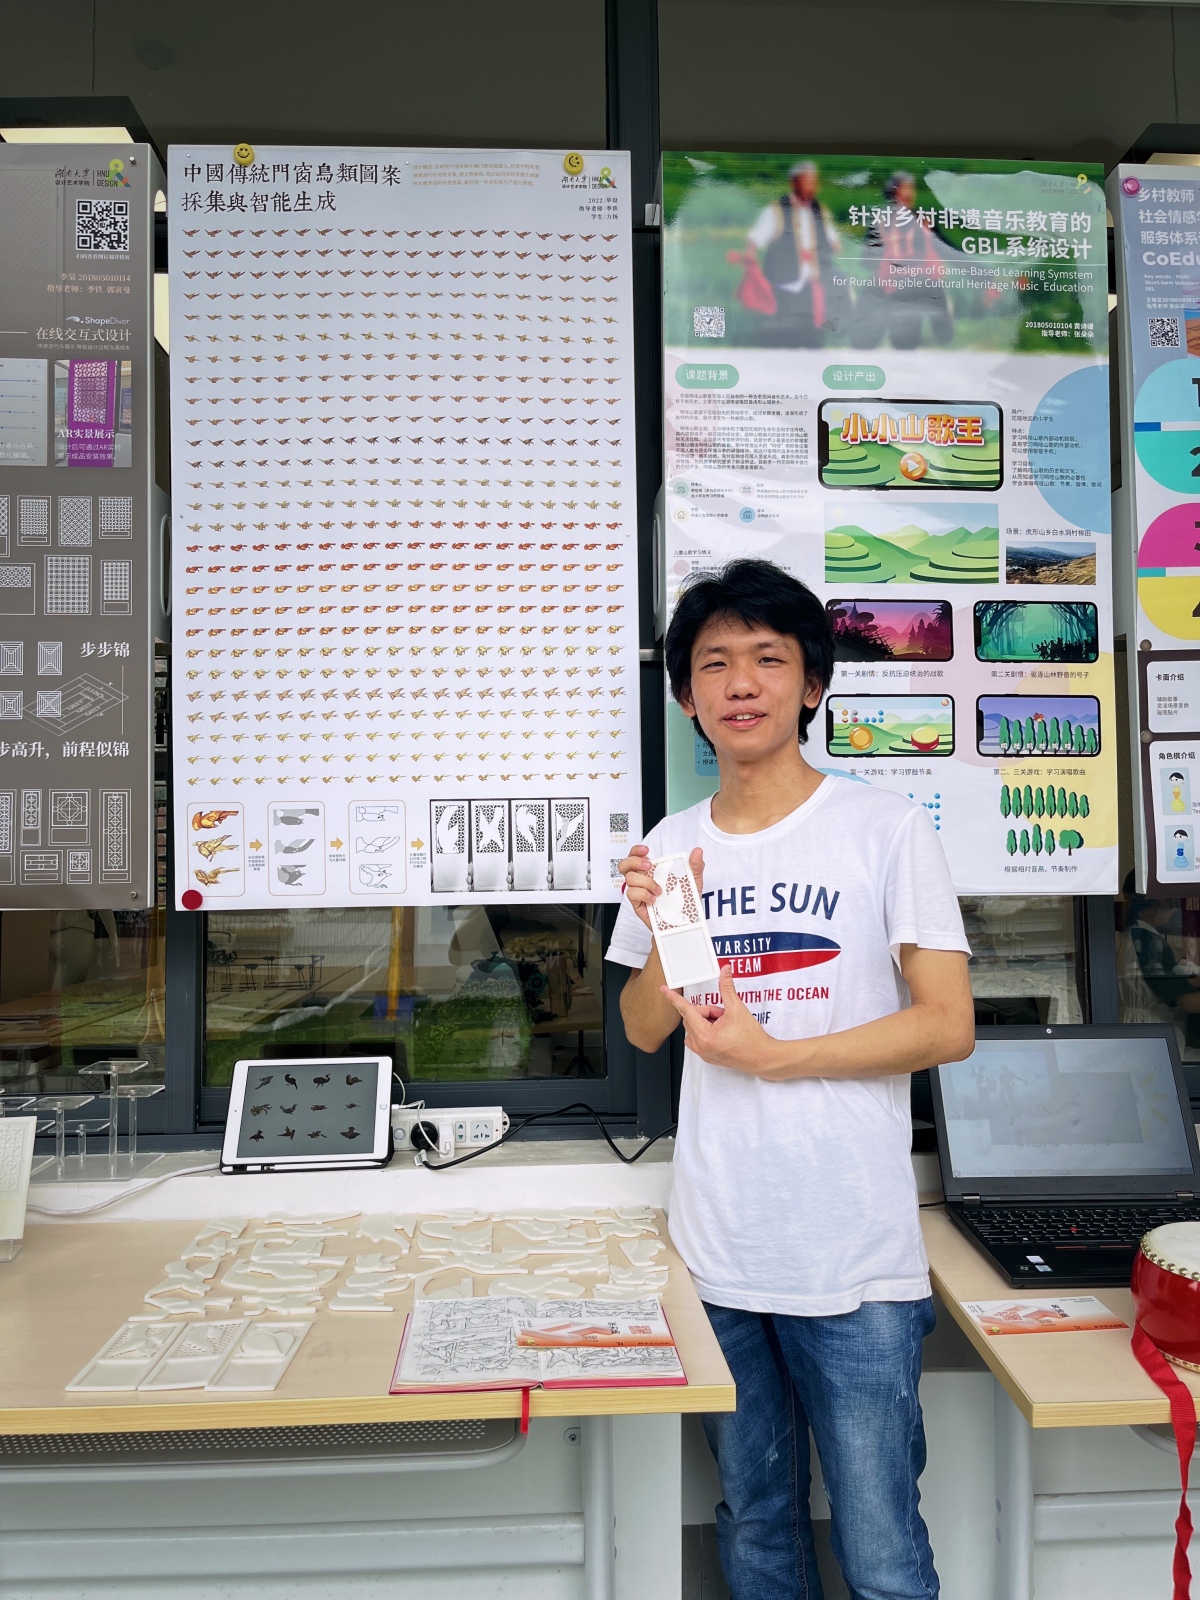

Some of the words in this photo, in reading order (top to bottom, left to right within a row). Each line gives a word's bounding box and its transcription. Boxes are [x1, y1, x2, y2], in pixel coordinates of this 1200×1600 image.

[97, 170, 109, 178] HNU
[181, 190, 337, 214] 採集與智能生成
[1138, 188, 1195, 204] 乡村教师
[848, 205, 1092, 233] 针对乡村非遗音乐教育的
[1140, 230, 1200, 246] 服务体系
[961, 236, 1092, 260] GBL系统设计
[889, 264, 923, 276] Design
[925, 265, 936, 275] of
[937, 266, 1000, 277] Game-Based
[1002, 267, 1045, 280] Learning
[1047, 269, 1093, 281] Symstem
[832, 276, 847, 287] for
[849, 276, 876, 287] Rural
[878, 277, 922, 290] Intagible
[924, 278, 965, 289] Cultural
[967, 279, 1009, 292] Heritage
[1011, 281, 1039, 291] Music
[1043, 281, 1093, 293] Education
[85, 316, 130, 326] ShapeDiver
[35, 326, 132, 342] 在线交互式设计
[685, 369, 729, 381] 课题背景
[832, 370, 876, 382] 设计产出
[57, 428, 115, 439] AR实景展示
[840, 412, 985, 447] 小小山歌王
[80, 641, 130, 658] 步步锦
[1155, 673, 1185, 681] 卡面介绍
[701, 886, 756, 920] THE
[770, 882, 841, 921] SUN
[715, 937, 773, 955] VARSITY
[729, 957, 762, 974] TEAM
[764, 988, 782, 1001] THE
[787, 987, 830, 1000] OCEAN
